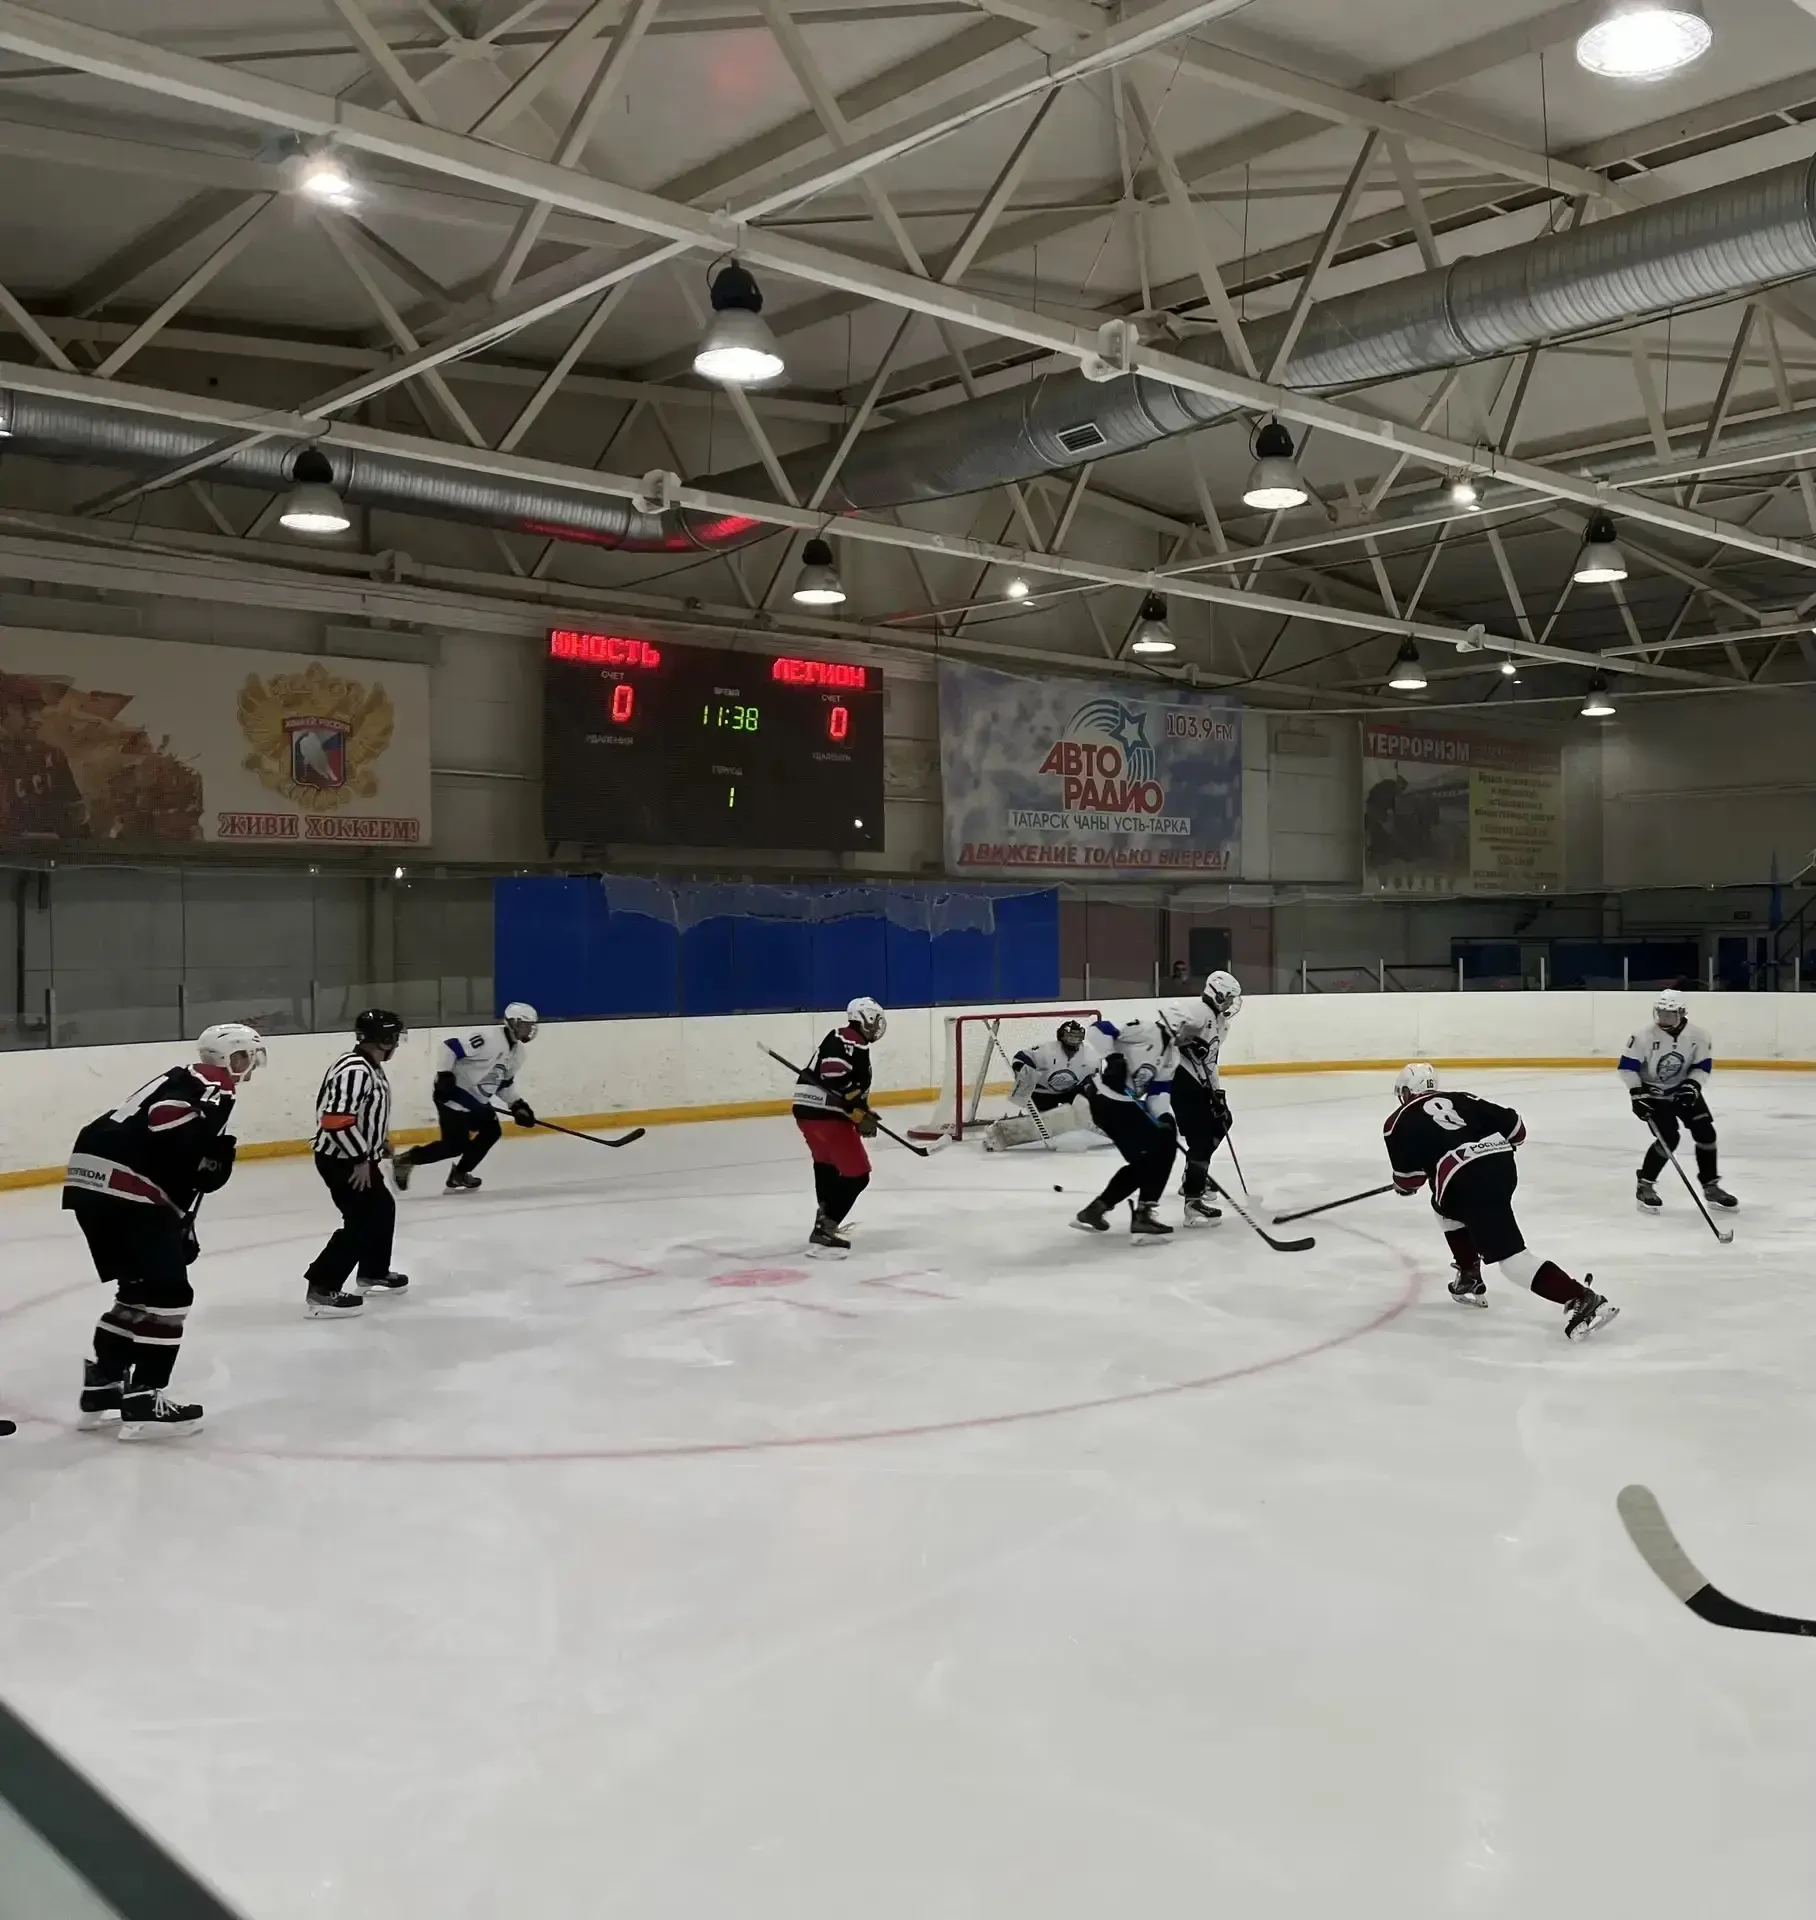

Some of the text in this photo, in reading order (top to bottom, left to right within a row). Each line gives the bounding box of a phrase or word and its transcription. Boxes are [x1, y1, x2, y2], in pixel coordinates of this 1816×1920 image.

[551, 631, 661, 667] ЮНОСТЬ
[772, 657, 867, 688] ЛЕГИОН
[612, 685, 633, 721] 0
[702, 705, 760, 731] 11:38
[829, 707, 848, 738] 0
[1166, 713, 1233, 740] 103.9 FM
[1038, 741, 1122, 778] АВТО
[1368, 733, 1470, 761] ТЕРРОРИЗМ
[1063, 778, 1164, 813] РАДИО
[219, 813, 419, 841] ЖИВИ ХОККЕЕМ!
[1012, 813, 1189, 834] ТАТАРСК ЧАНЫ УСТЬ-ТАРКА
[958, 843, 1077, 866] ДВИЖЕНИЕ
[1083, 847, 1153, 868] ТОЛЬКО
[469, 1034, 485, 1050] 10
